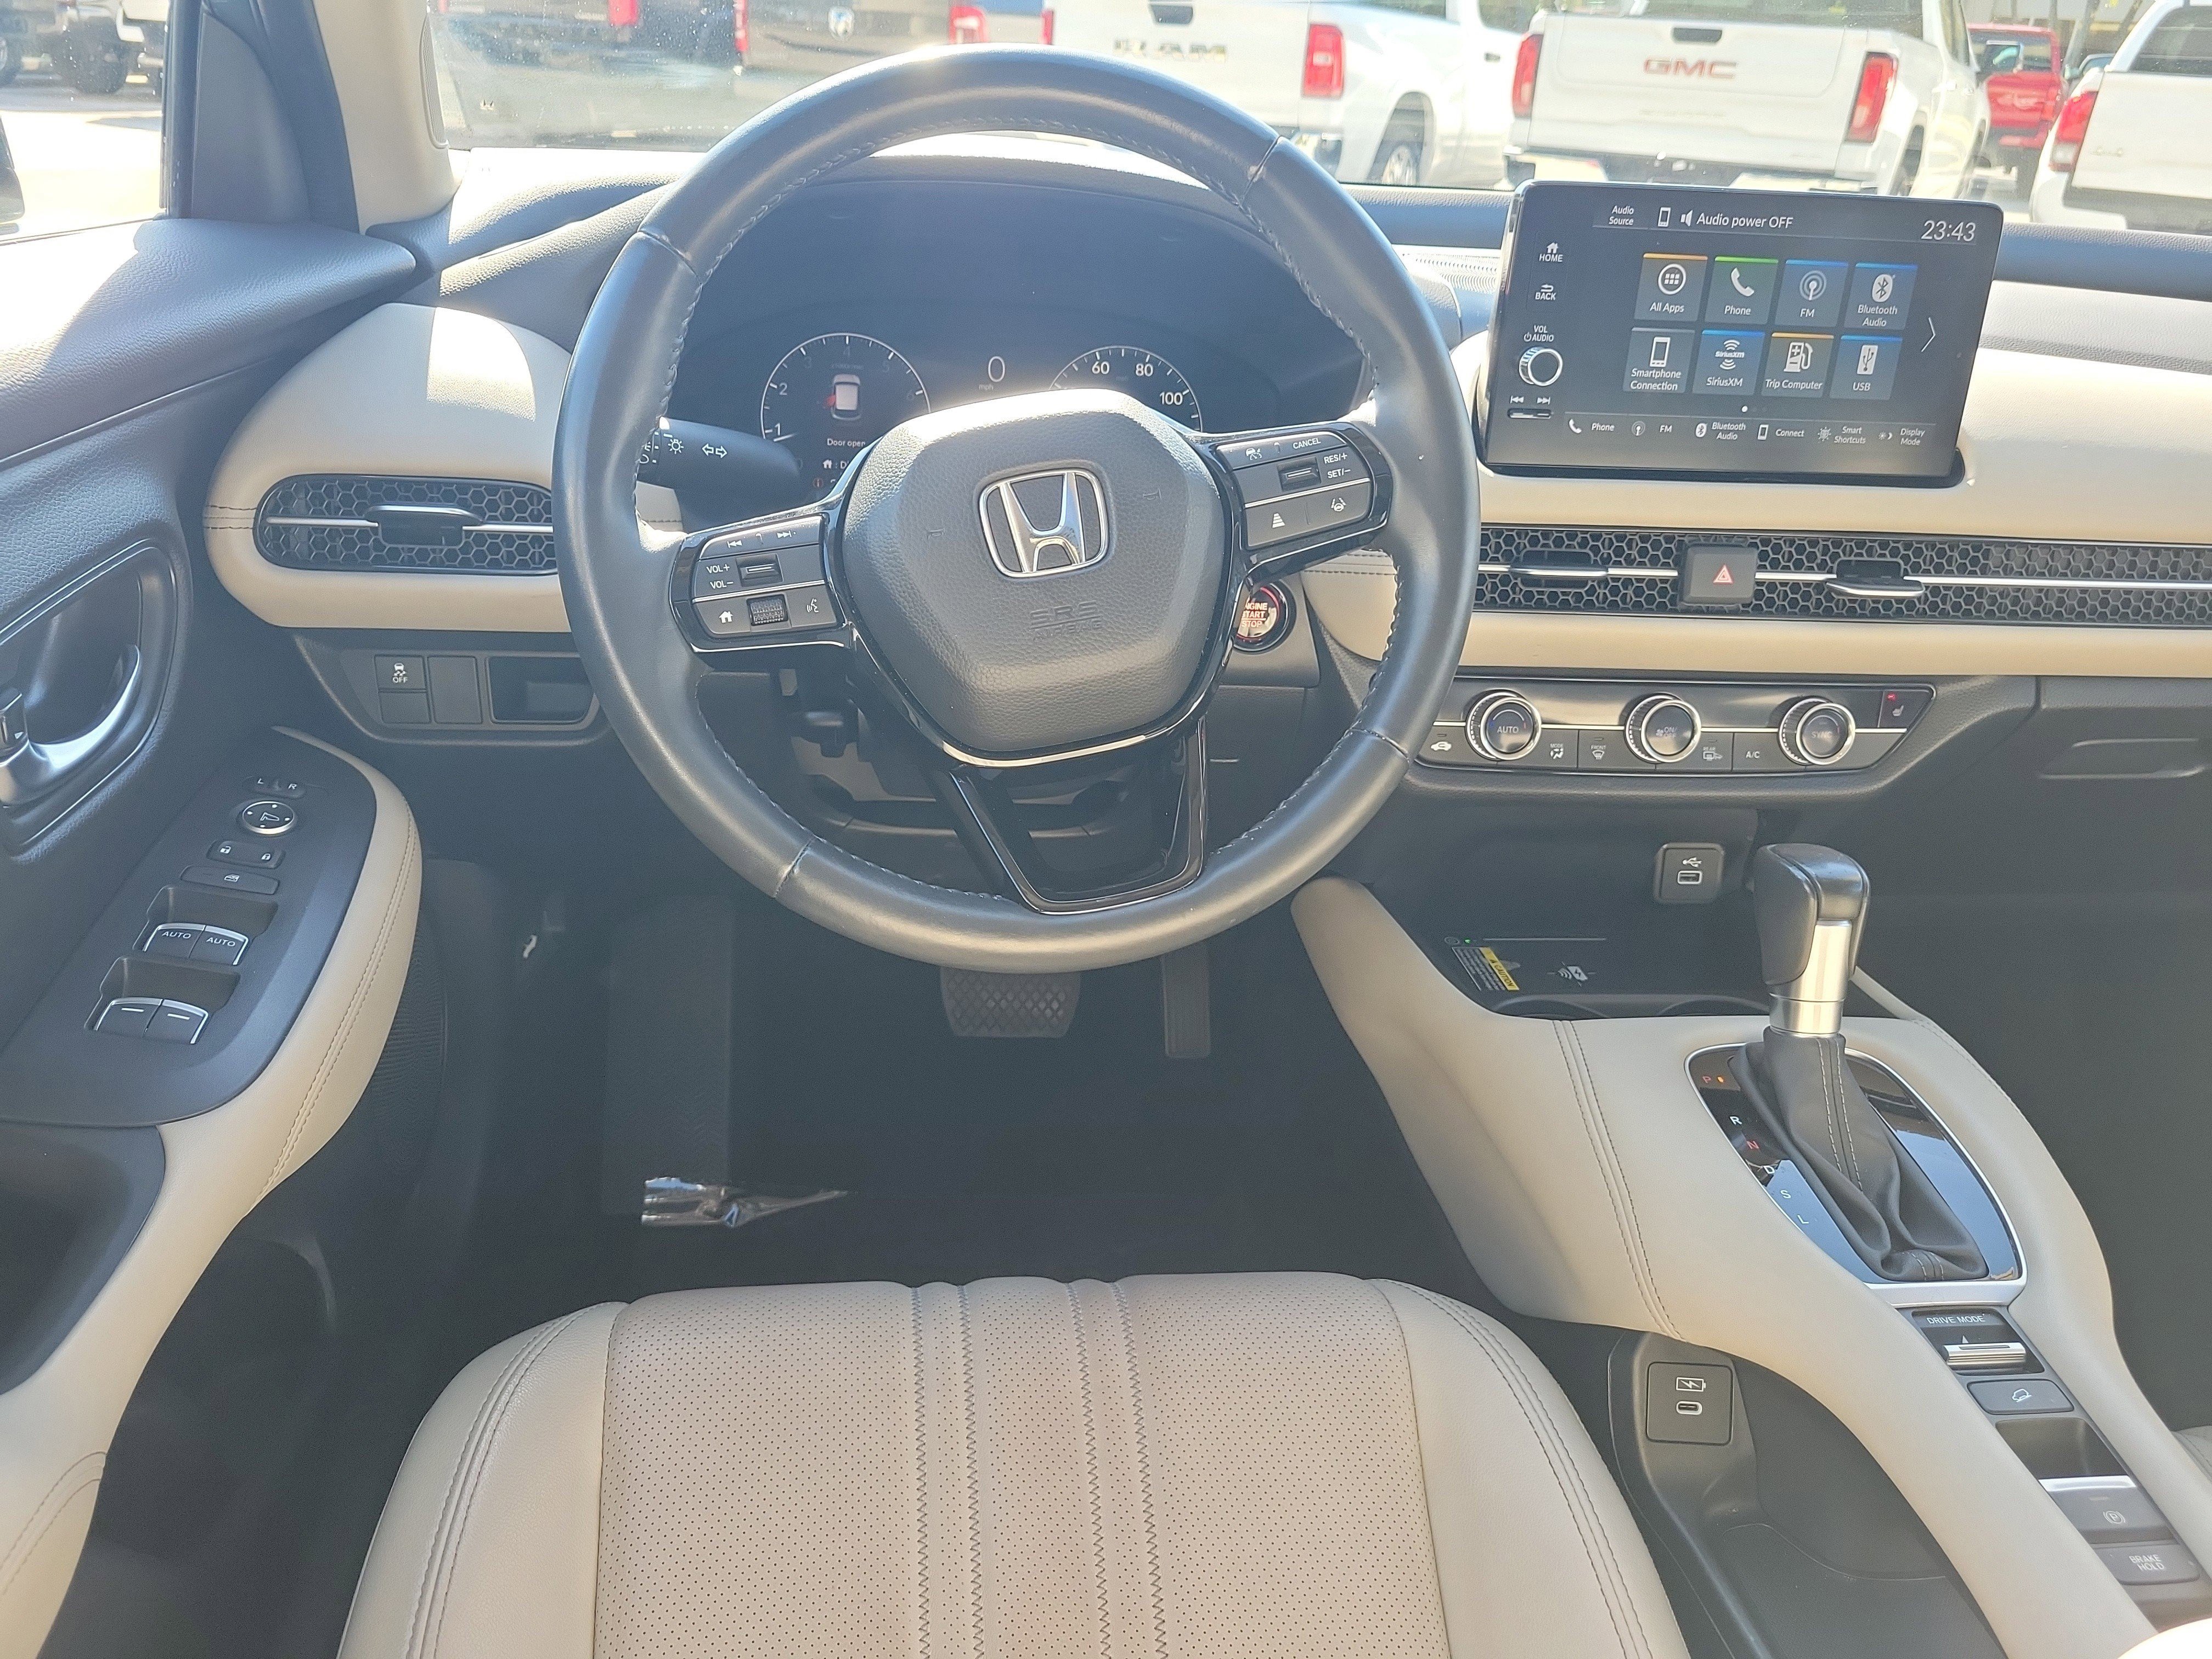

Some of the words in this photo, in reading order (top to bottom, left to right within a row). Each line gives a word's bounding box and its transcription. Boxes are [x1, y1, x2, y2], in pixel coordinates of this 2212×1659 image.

[1644, 59, 1737, 80] GMC
[1612, 206, 1634, 215] Audio
[1609, 217, 1634, 225] Source
[1696, 212, 1729, 227] Audio
[1731, 218, 1767, 229] power
[1769, 217, 1793, 229] OFF
[1921, 219, 1976, 241] 23:43
[1539, 253, 1564, 262] HOME
[1535, 292, 1556, 301] BACK
[1650, 302, 1663, 312] All
[1663, 303, 1685, 314] Apps
[1724, 304, 1751, 315] Phone
[1858, 304, 1898, 315] Bluetooth
[1800, 309, 1815, 318] FM
[1863, 317, 1887, 327] Audio
[1532, 334, 1554, 342] AUDIO
[988, 356, 1006, 382] 0
[1092, 361, 1110, 375] 60
[1135, 363, 1153, 377] 80
[1631, 368, 1681, 380] Smartphone
[1630, 380, 1678, 391] Connection
[1706, 376, 1743, 387] SiriusXM
[1765, 379, 1781, 389] Trip
[1782, 380, 1822, 390] Computer
[779, 383, 787, 395] 2
[1853, 382, 1871, 391] USB
[1160, 392, 1183, 405] 100
[774, 423, 781, 436] 1
[1592, 422, 1615, 431] Phone
[1711, 422, 1746, 431] Bluetooth
[1842, 426, 1862, 434] Smart
[1717, 432, 1737, 440] Audio
[1775, 428, 1804, 437] Connect
[1900, 428, 1926, 437] Display
[1293, 438, 1321, 449] CANCEL
[1834, 435, 1865, 444] Shortcuts
[1324, 454, 1348, 464] RES/+
[706, 563, 730, 574] VOL+
[1244, 602, 1268, 611] NGINE
[206, 937, 235, 946] AUTO
[1730, 1116, 1742, 1125] R
[1746, 1141, 1759, 1149] N
[1763, 1165, 1775, 1174] D
[1780, 1190, 1791, 1199] S
[1797, 1215, 1809, 1224] L
[2129, 1554, 2162, 1563] BRAKE
[2137, 1562, 2165, 1571] HOLD
